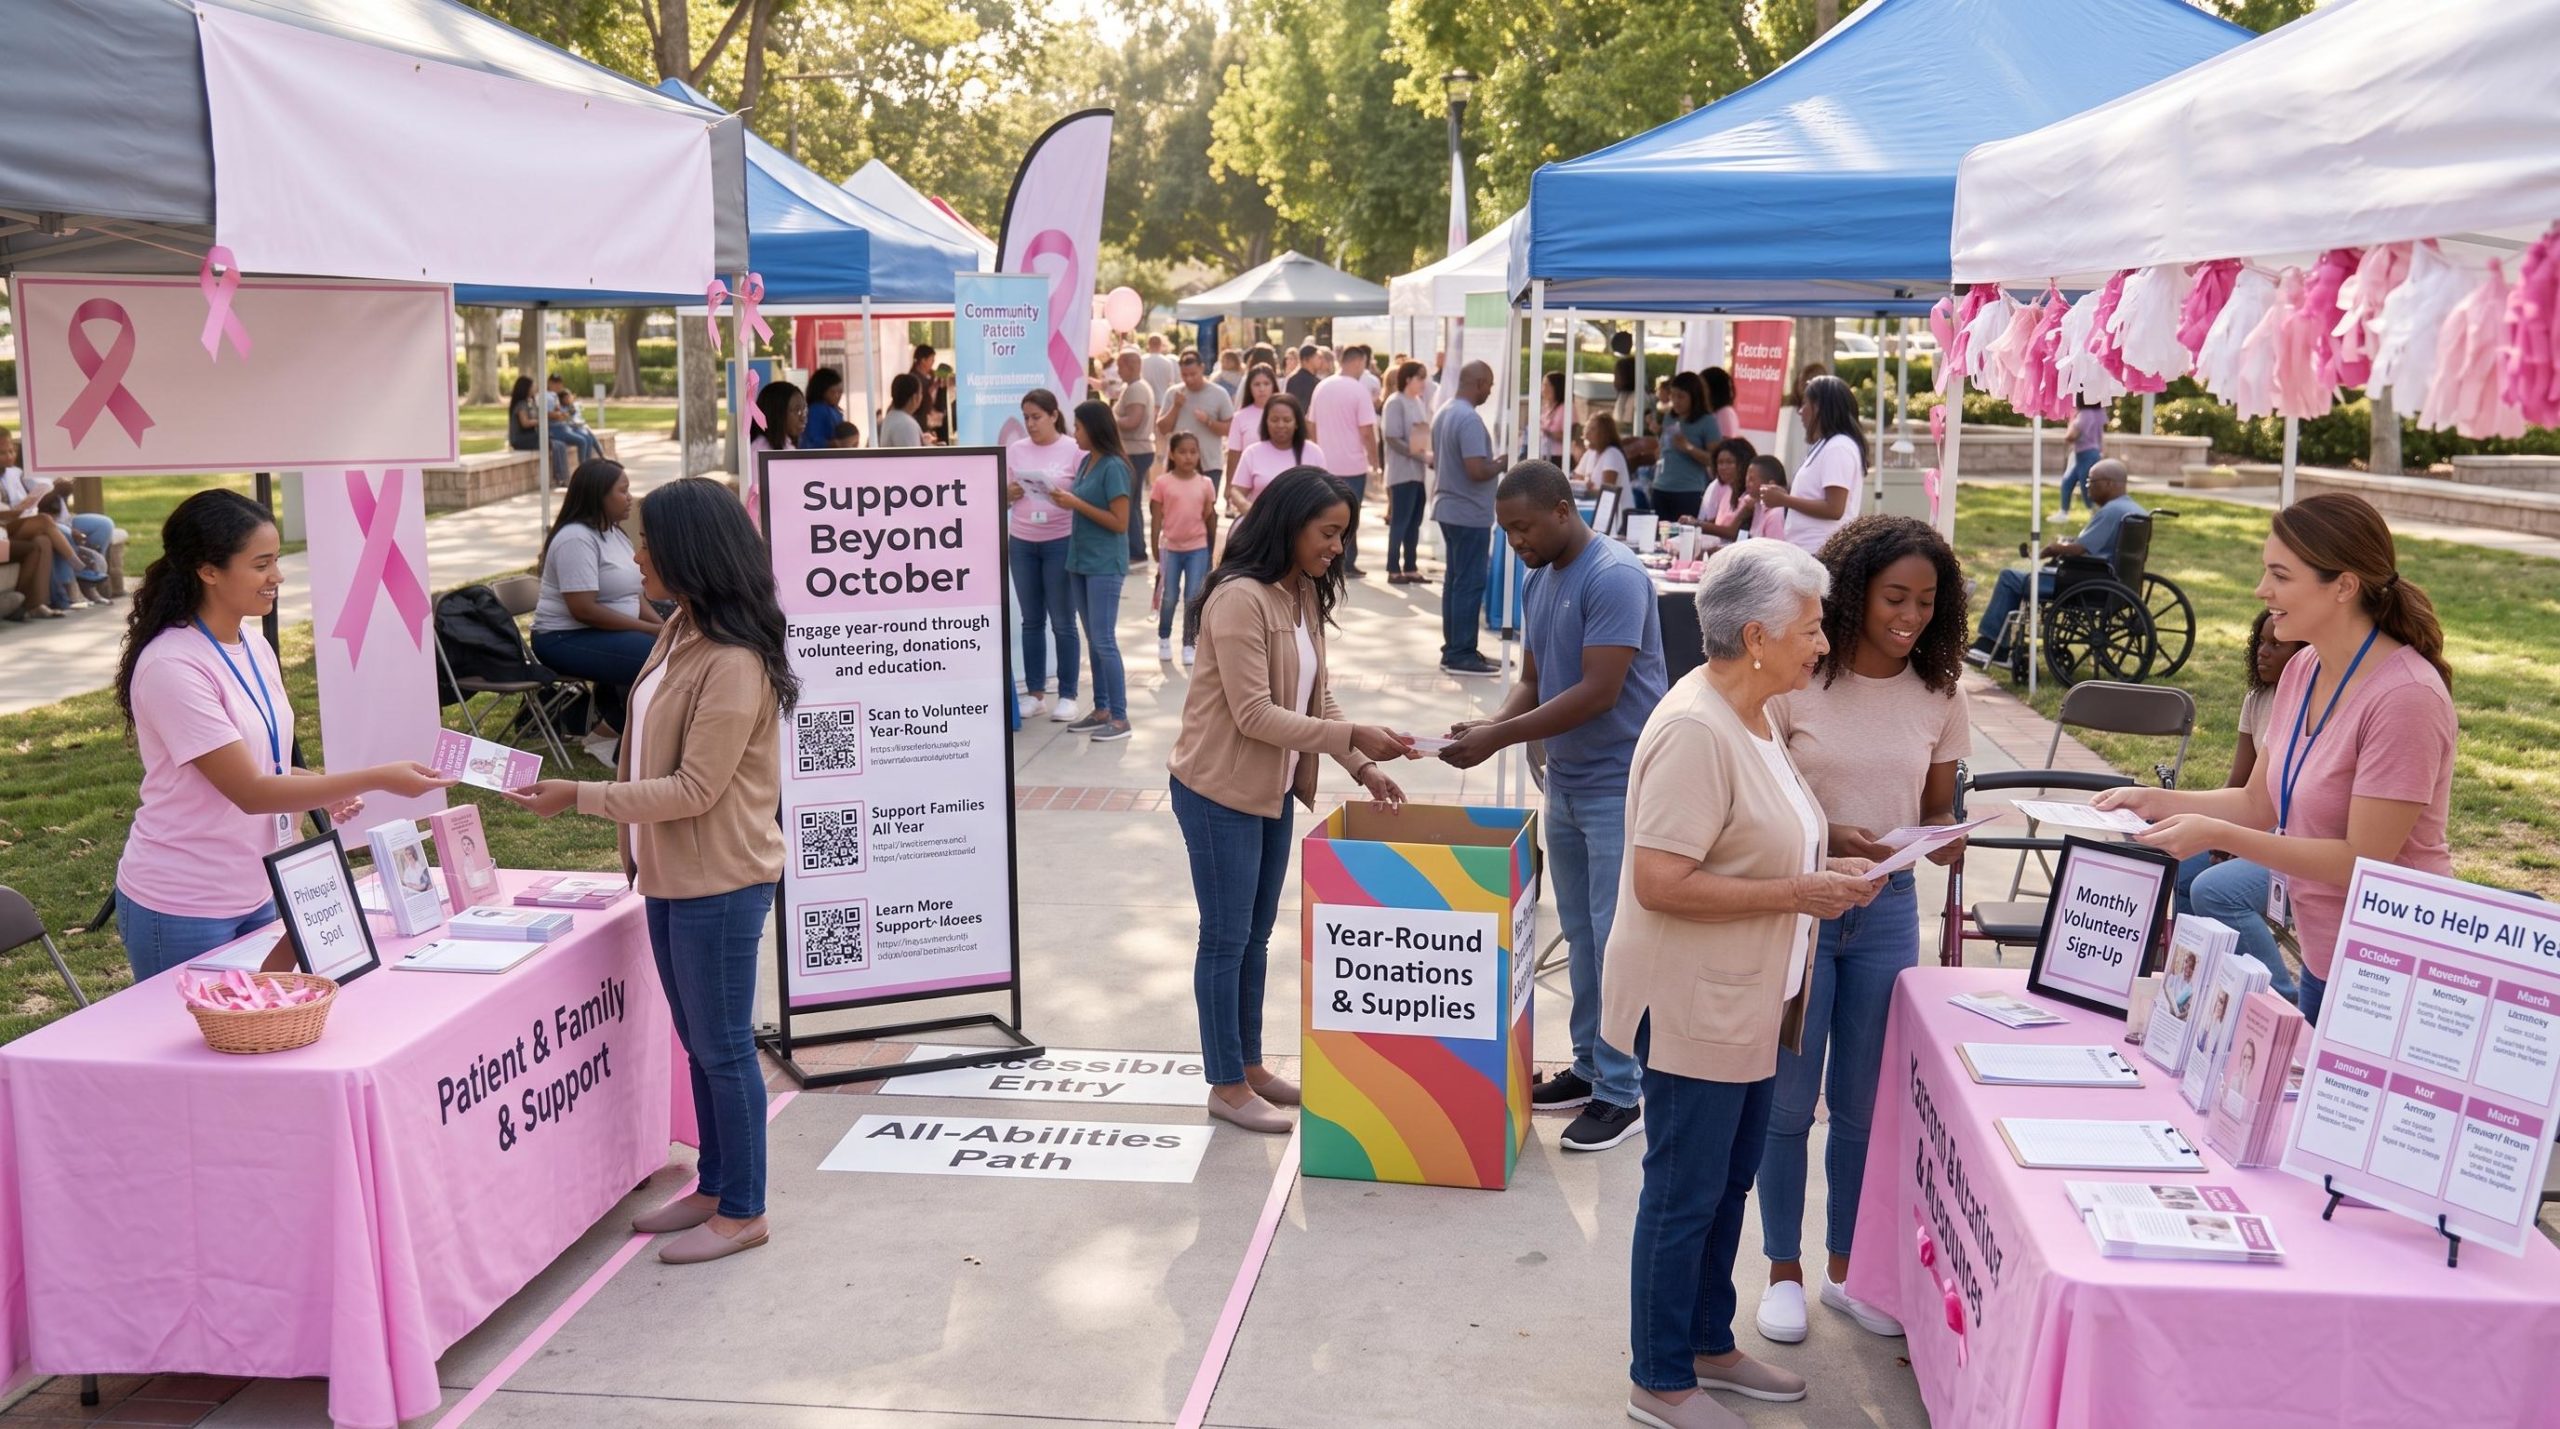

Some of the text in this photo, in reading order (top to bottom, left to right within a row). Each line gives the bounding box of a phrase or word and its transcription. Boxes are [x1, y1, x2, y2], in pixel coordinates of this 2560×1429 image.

[803, 479, 967, 517] Support
[810, 518, 963, 560] Beyond
[806, 563, 970, 597] October
[787, 614, 990, 640] Engage year-round through
[798, 637, 981, 658] volunteering, donations,
[835, 659, 946, 676] and education.
[868, 703, 989, 721] Scan to Volunteer
[870, 720, 948, 738] Year-Round
[872, 799, 985, 820] Support Families
[872, 821, 925, 836] All Year
[876, 899, 953, 916] Learn More
[2076, 885, 2138, 918] Monthly
[2064, 908, 2141, 943] Volunteers
[2362, 890, 2409, 919] How
[2414, 904, 2435, 926] to
[2440, 909, 2489, 943] Help
[2494, 924, 2526, 949] All
[1326, 922, 1482, 953] Year-Round
[2066, 935, 2123, 967] Sign-Up
[1335, 957, 1473, 986] Donations
[1332, 989, 1476, 1023] & Supplies
[437, 977, 625, 1126] Patient & Family
[946, 1053, 1203, 1076] cessible
[498, 1042, 611, 1152] & Support
[988, 1075, 1126, 1097] Entry
[865, 1122, 1182, 1150] All-Abilities
[948, 1149, 1073, 1171] Path
